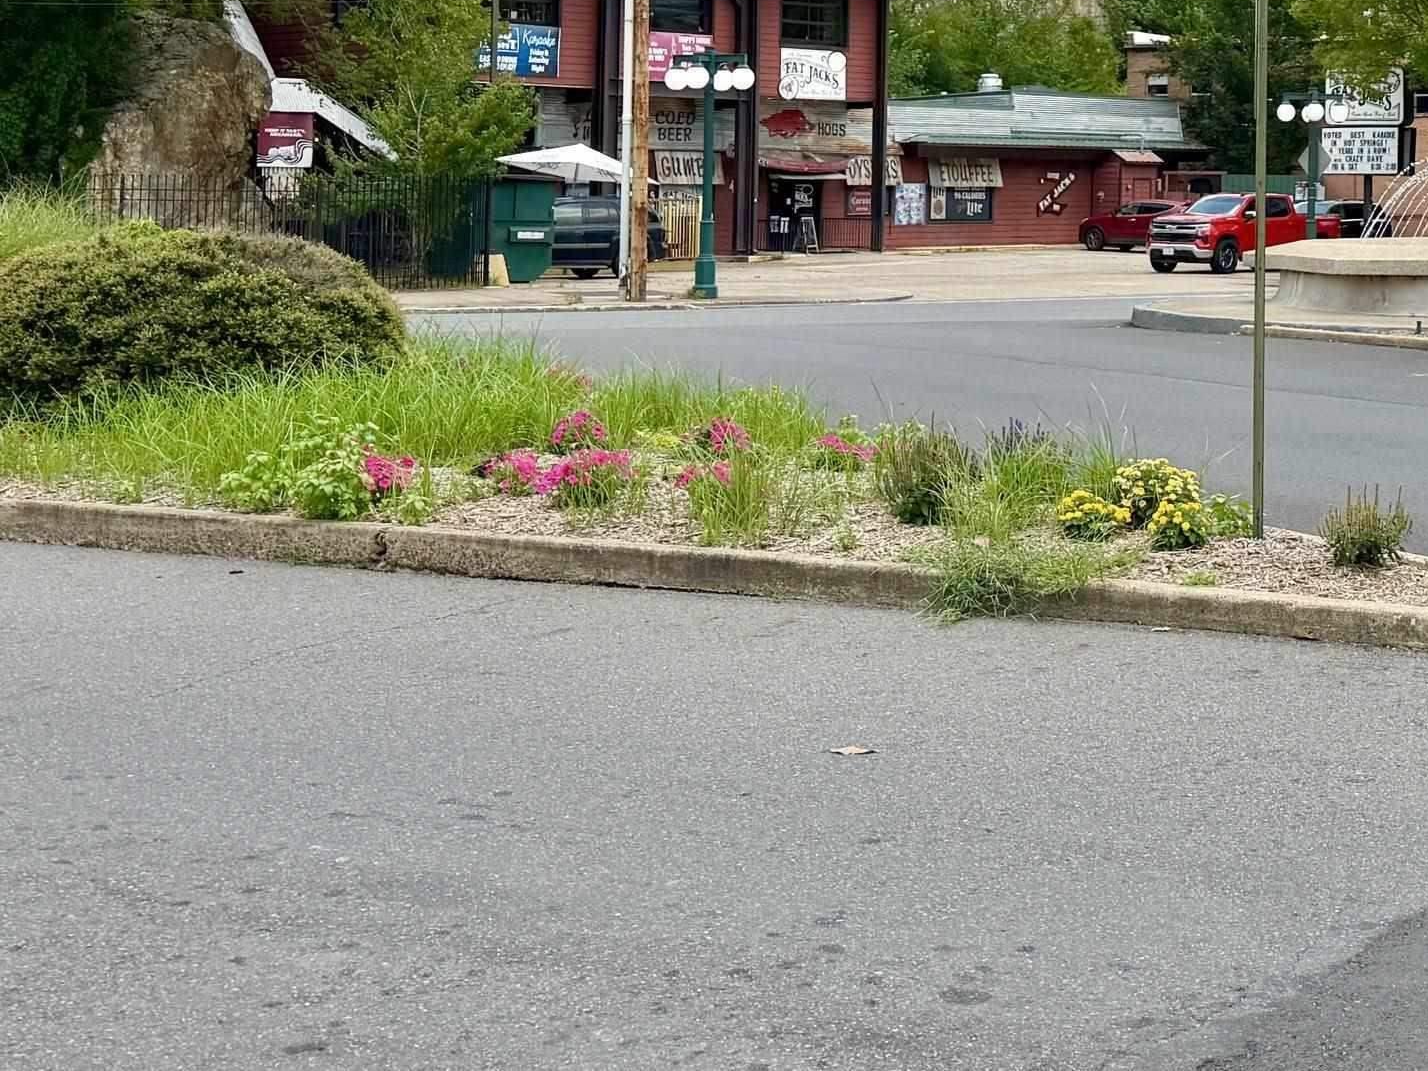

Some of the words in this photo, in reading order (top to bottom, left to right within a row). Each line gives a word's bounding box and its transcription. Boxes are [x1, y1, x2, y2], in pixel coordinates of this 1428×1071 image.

[523, 28, 556, 48] Karaoke
[785, 62, 805, 74] FAT
[806, 65, 839, 89] JACKS
[655, 110, 696, 125] COLD
[657, 128, 693, 142] BEER
[817, 122, 847, 137] HOGS
[1350, 131, 1365, 139] BEST
[661, 156, 706, 178] GUMB
[849, 159, 898, 179] OYSRS
